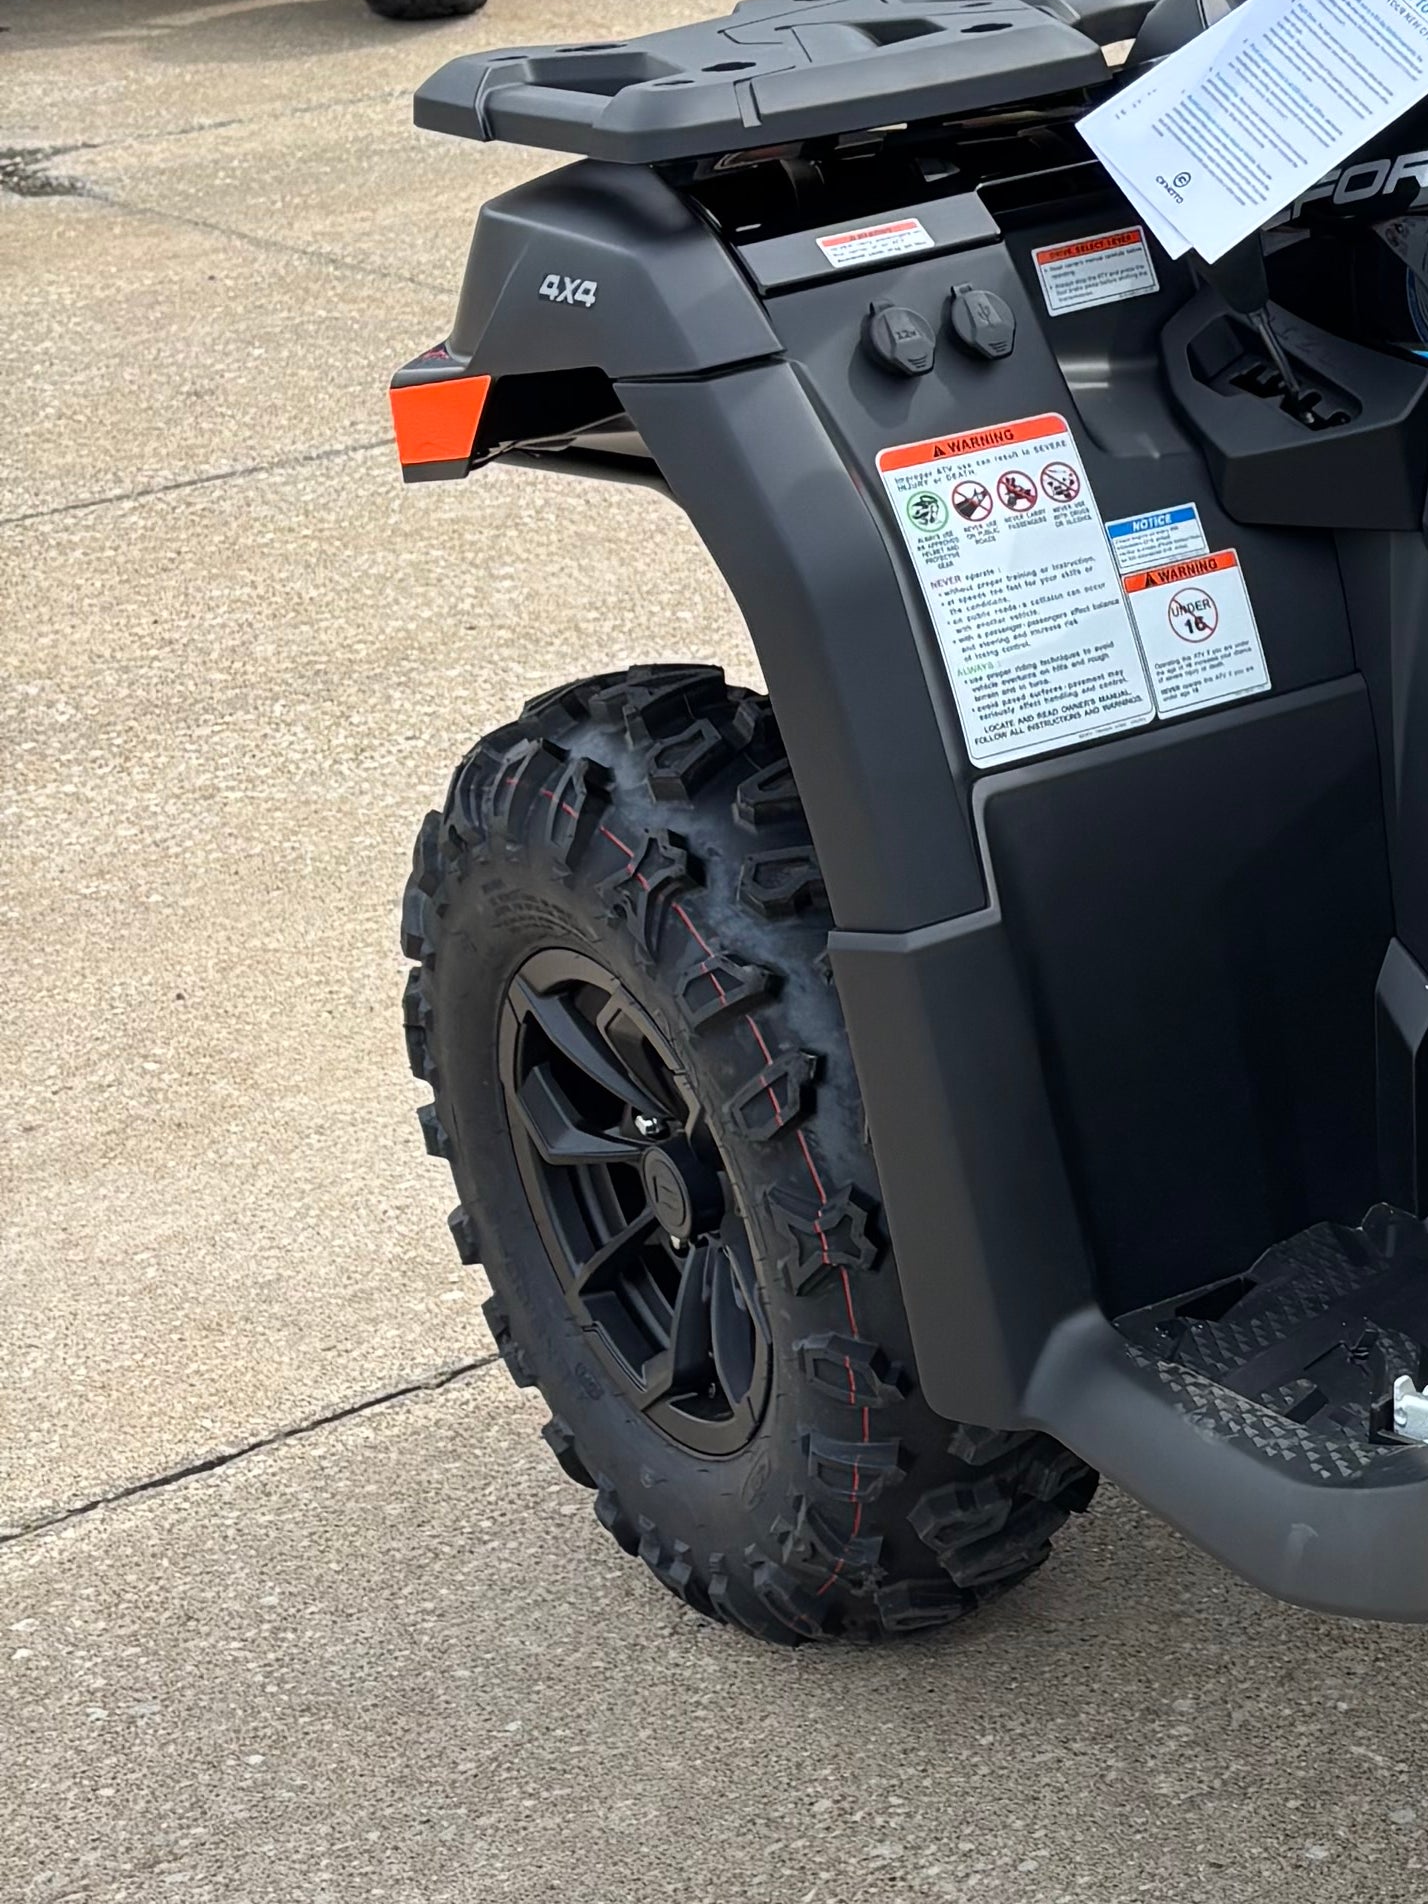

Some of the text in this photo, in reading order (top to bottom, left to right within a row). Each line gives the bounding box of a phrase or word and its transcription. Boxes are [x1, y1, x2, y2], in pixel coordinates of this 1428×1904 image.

[538, 273, 600, 309] 4X4
[947, 428, 1015, 453] WARNING
[1130, 512, 1173, 532] NOTICE
[1156, 557, 1218, 583] WARNING
[1170, 598, 1211, 618] UNDER
[1183, 614, 1207, 635] 16
[973, 730, 1008, 748] FOLLOW
[1008, 725, 1025, 738] ALL
[1025, 709, 1082, 733] INSTRUCTIONS
[1082, 704, 1101, 717] AND
[983, 719, 1015, 735] LOCATE
[1016, 713, 1035, 726] AND
[1035, 707, 1059, 721] READ
[1059, 696, 1096, 714] OWNER'S
